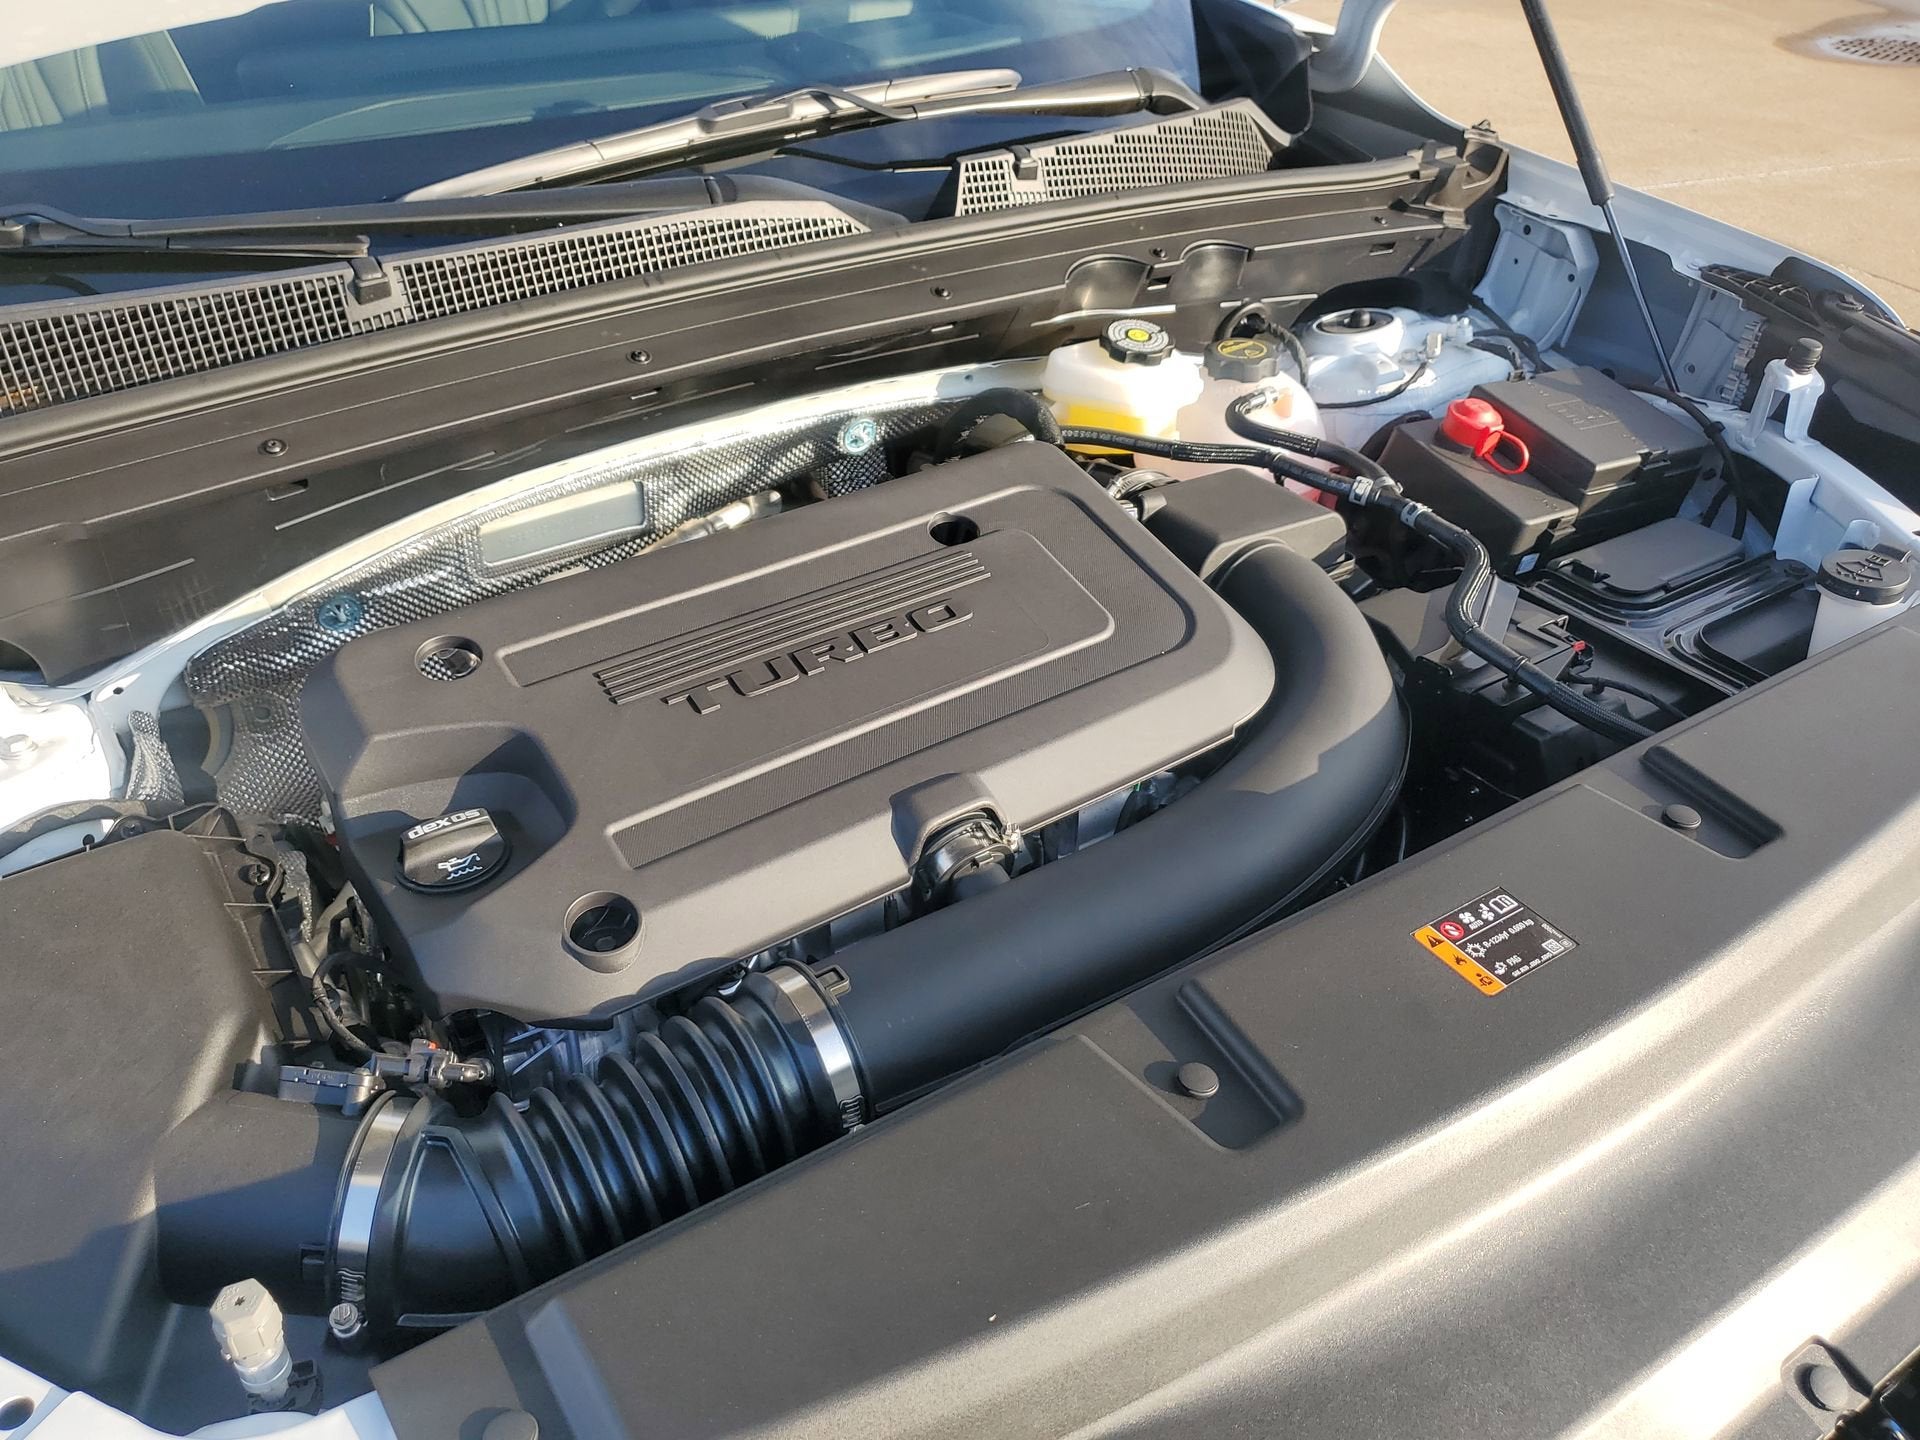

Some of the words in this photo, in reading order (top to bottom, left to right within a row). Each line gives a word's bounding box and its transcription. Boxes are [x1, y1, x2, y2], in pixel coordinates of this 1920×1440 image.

[660, 598, 974, 715] TURBO
[408, 810, 481, 839] dexos
[1469, 920, 1484, 930] AUTO
[1506, 955, 1522, 966] PAG
